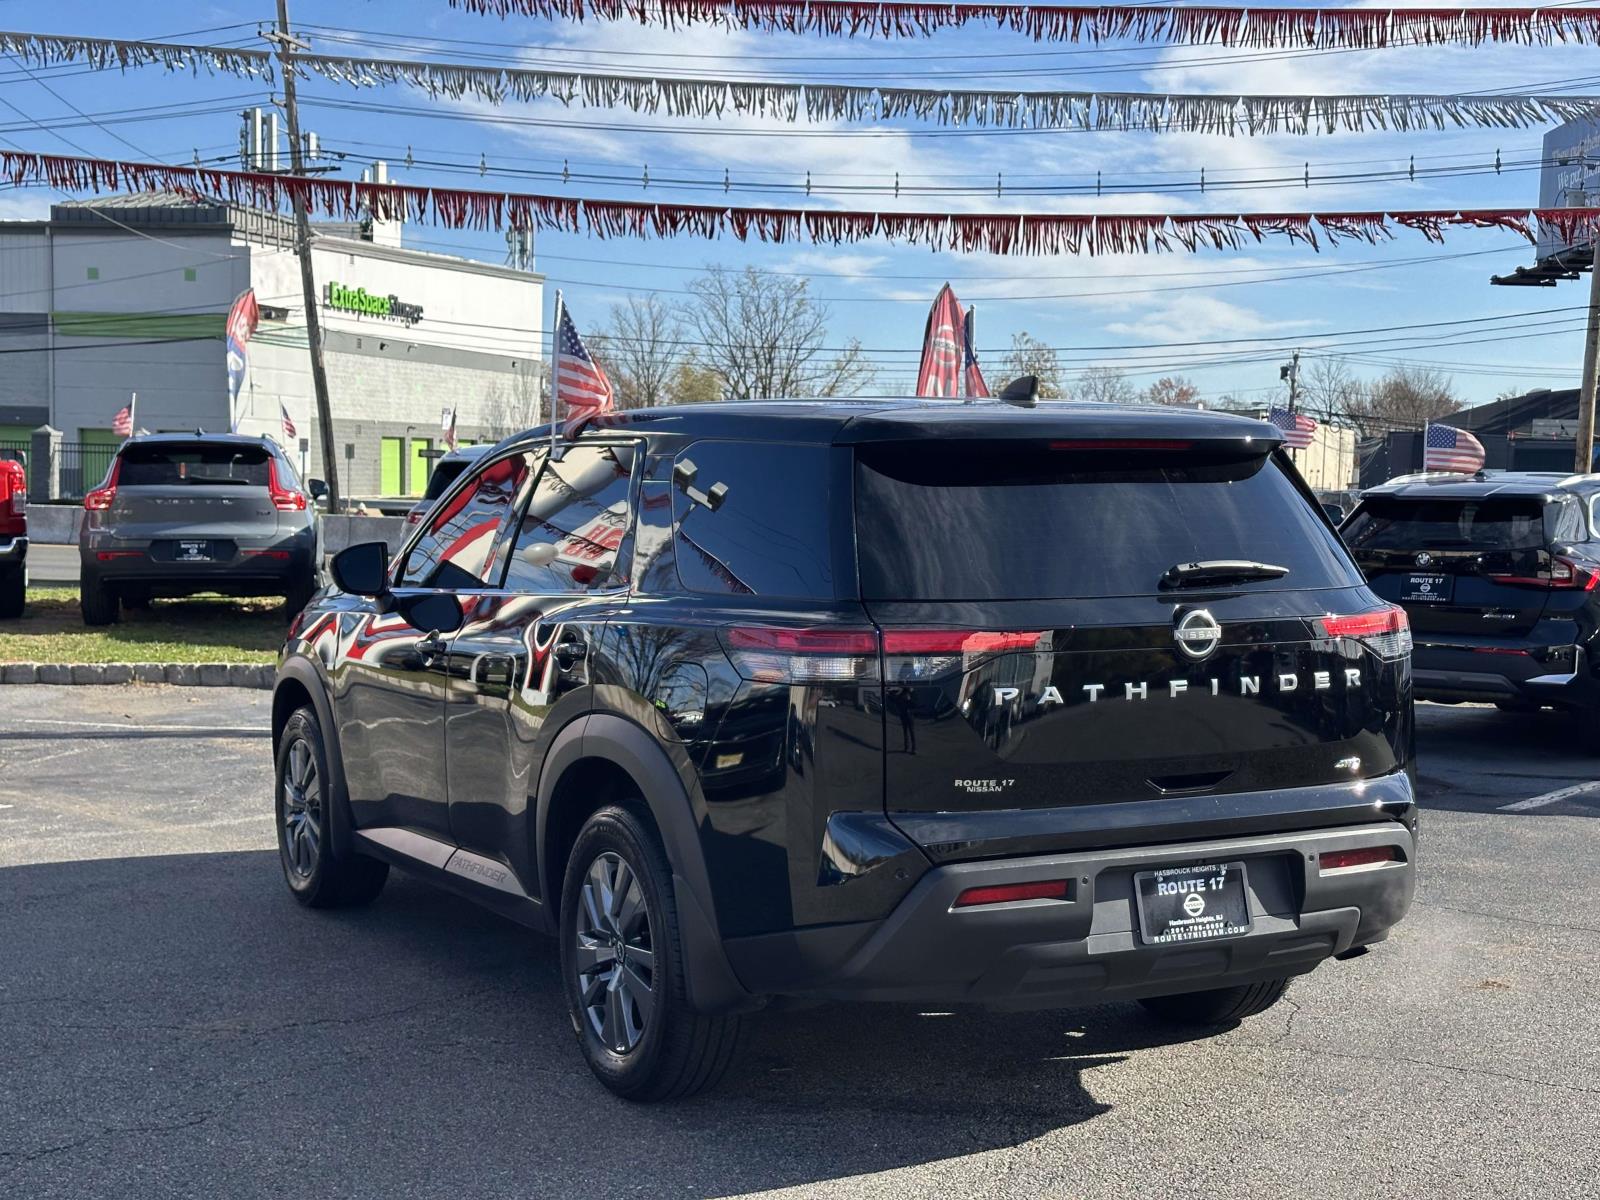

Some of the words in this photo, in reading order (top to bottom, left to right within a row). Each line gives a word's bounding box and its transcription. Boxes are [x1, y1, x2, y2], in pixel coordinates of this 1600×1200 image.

[1175, 630, 1220, 639] NISSAN
[993, 668, 1361, 706] PATHFINDER
[954, 779, 997, 787] ROUTE
[450, 856, 508, 883] PATHFINDER
[1154, 867, 1190, 877] HASBROUCK
[1158, 879, 1206, 896] ROUTE
[1209, 876, 1225, 891] 17
[1154, 926, 1245, 943] ROUTE17NISSAN.COM
